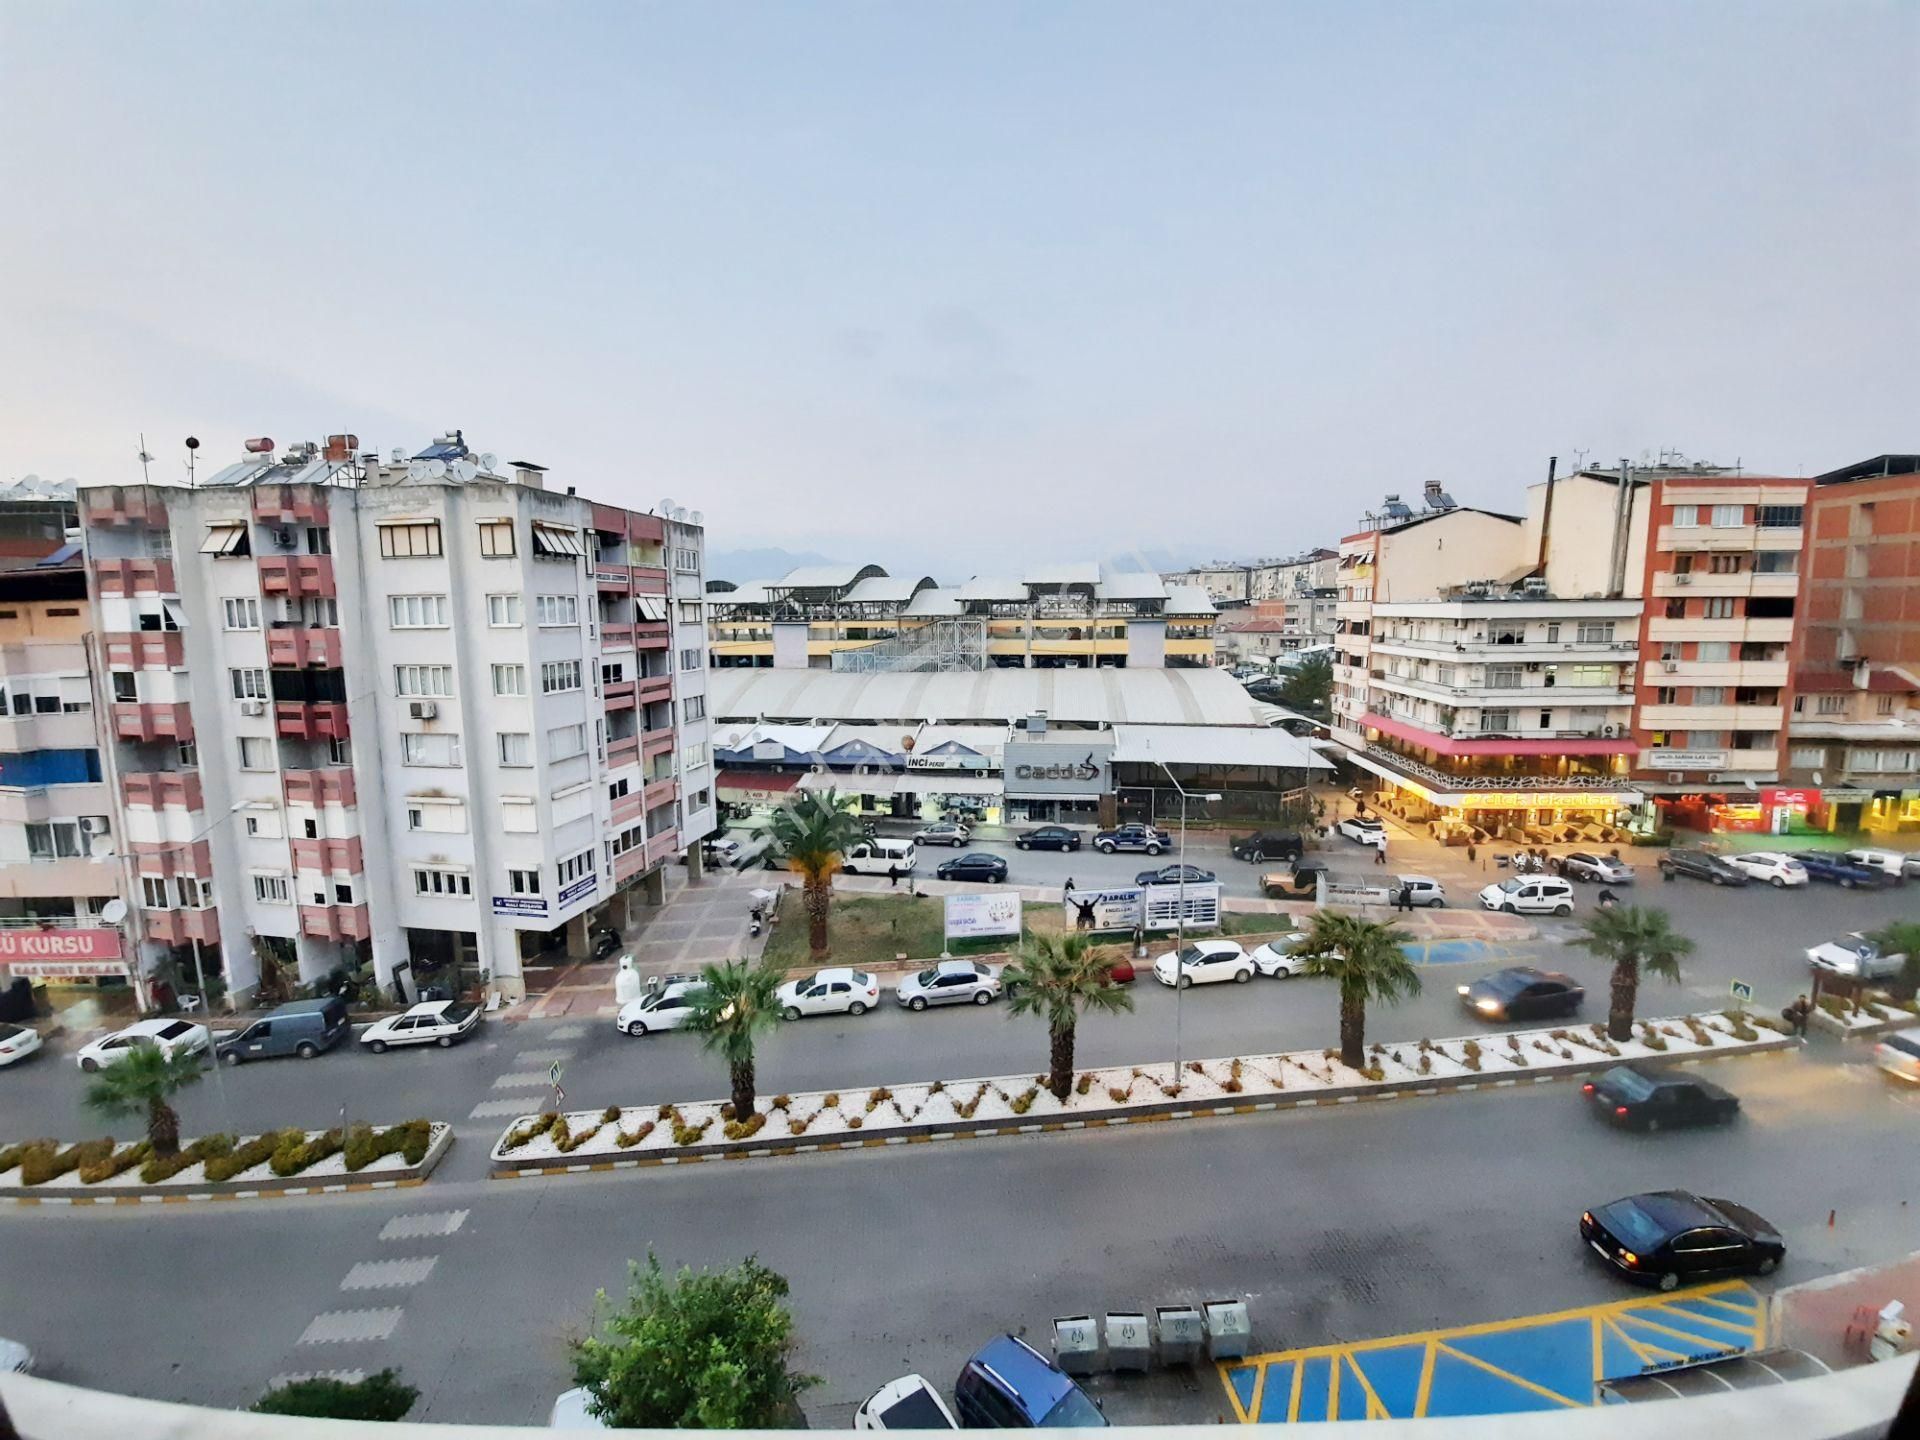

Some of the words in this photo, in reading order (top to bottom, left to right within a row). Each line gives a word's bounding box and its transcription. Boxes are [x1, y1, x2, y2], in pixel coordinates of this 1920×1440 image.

[907, 756, 928, 767] İNCİ
[1015, 763, 1089, 780] Cadde
[1109, 893, 1136, 901] ARALIK
[0, 931, 16, 955] Ü
[20, 936, 94, 954] KURSU
